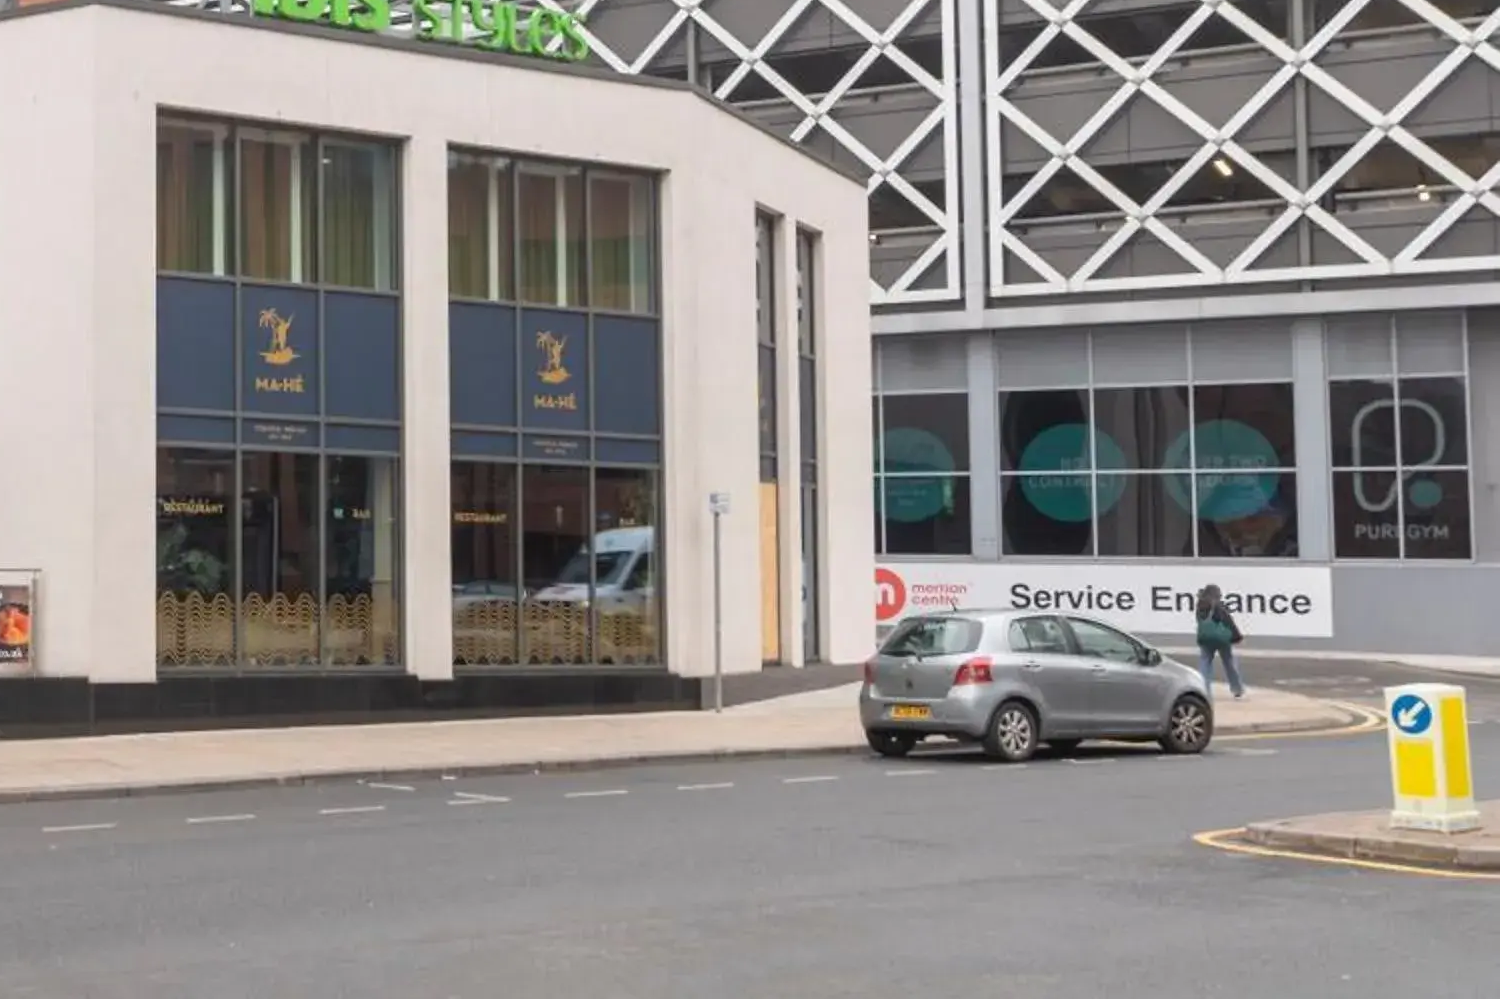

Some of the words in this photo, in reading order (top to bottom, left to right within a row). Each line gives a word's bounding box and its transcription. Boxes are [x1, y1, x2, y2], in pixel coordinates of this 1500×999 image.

[162, 501, 225, 514] RESTAURANT
[453, 511, 508, 523] RESTAURANT
[1010, 584, 1135, 611] Service
[1151, 585, 1312, 615] Enance
